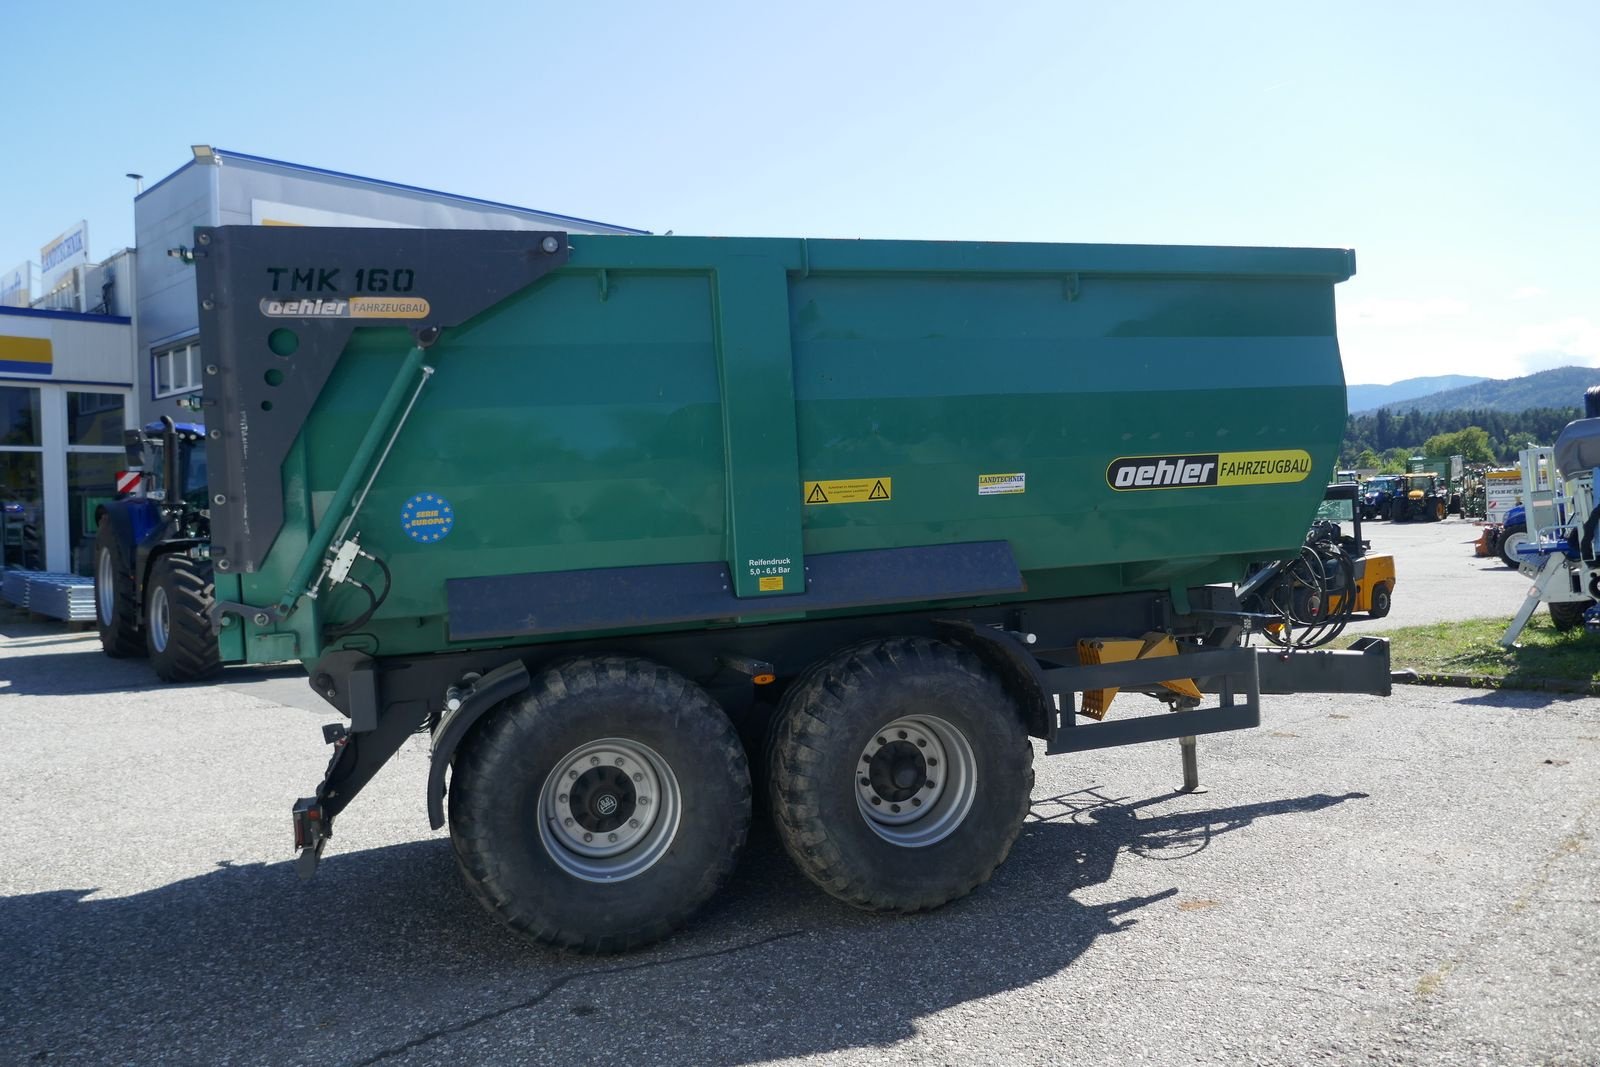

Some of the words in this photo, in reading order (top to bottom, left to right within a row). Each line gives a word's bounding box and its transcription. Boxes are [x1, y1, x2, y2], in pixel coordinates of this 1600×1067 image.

[267, 267, 341, 292] TMK
[355, 268, 415, 292] 160
[267, 299, 348, 315] oehler
[353, 303, 426, 313] FAHRZEUGBAU
[1114, 459, 1215, 487] oehler
[1220, 458, 1310, 477] FAHRZEUGBAU
[980, 475, 1024, 484] LANDTECHNIK
[411, 518, 445, 526] EUROPA
[748, 558, 791, 566] Reifendruck
[750, 568, 761, 576] 5,0
[766, 567, 777, 575] 6,5
